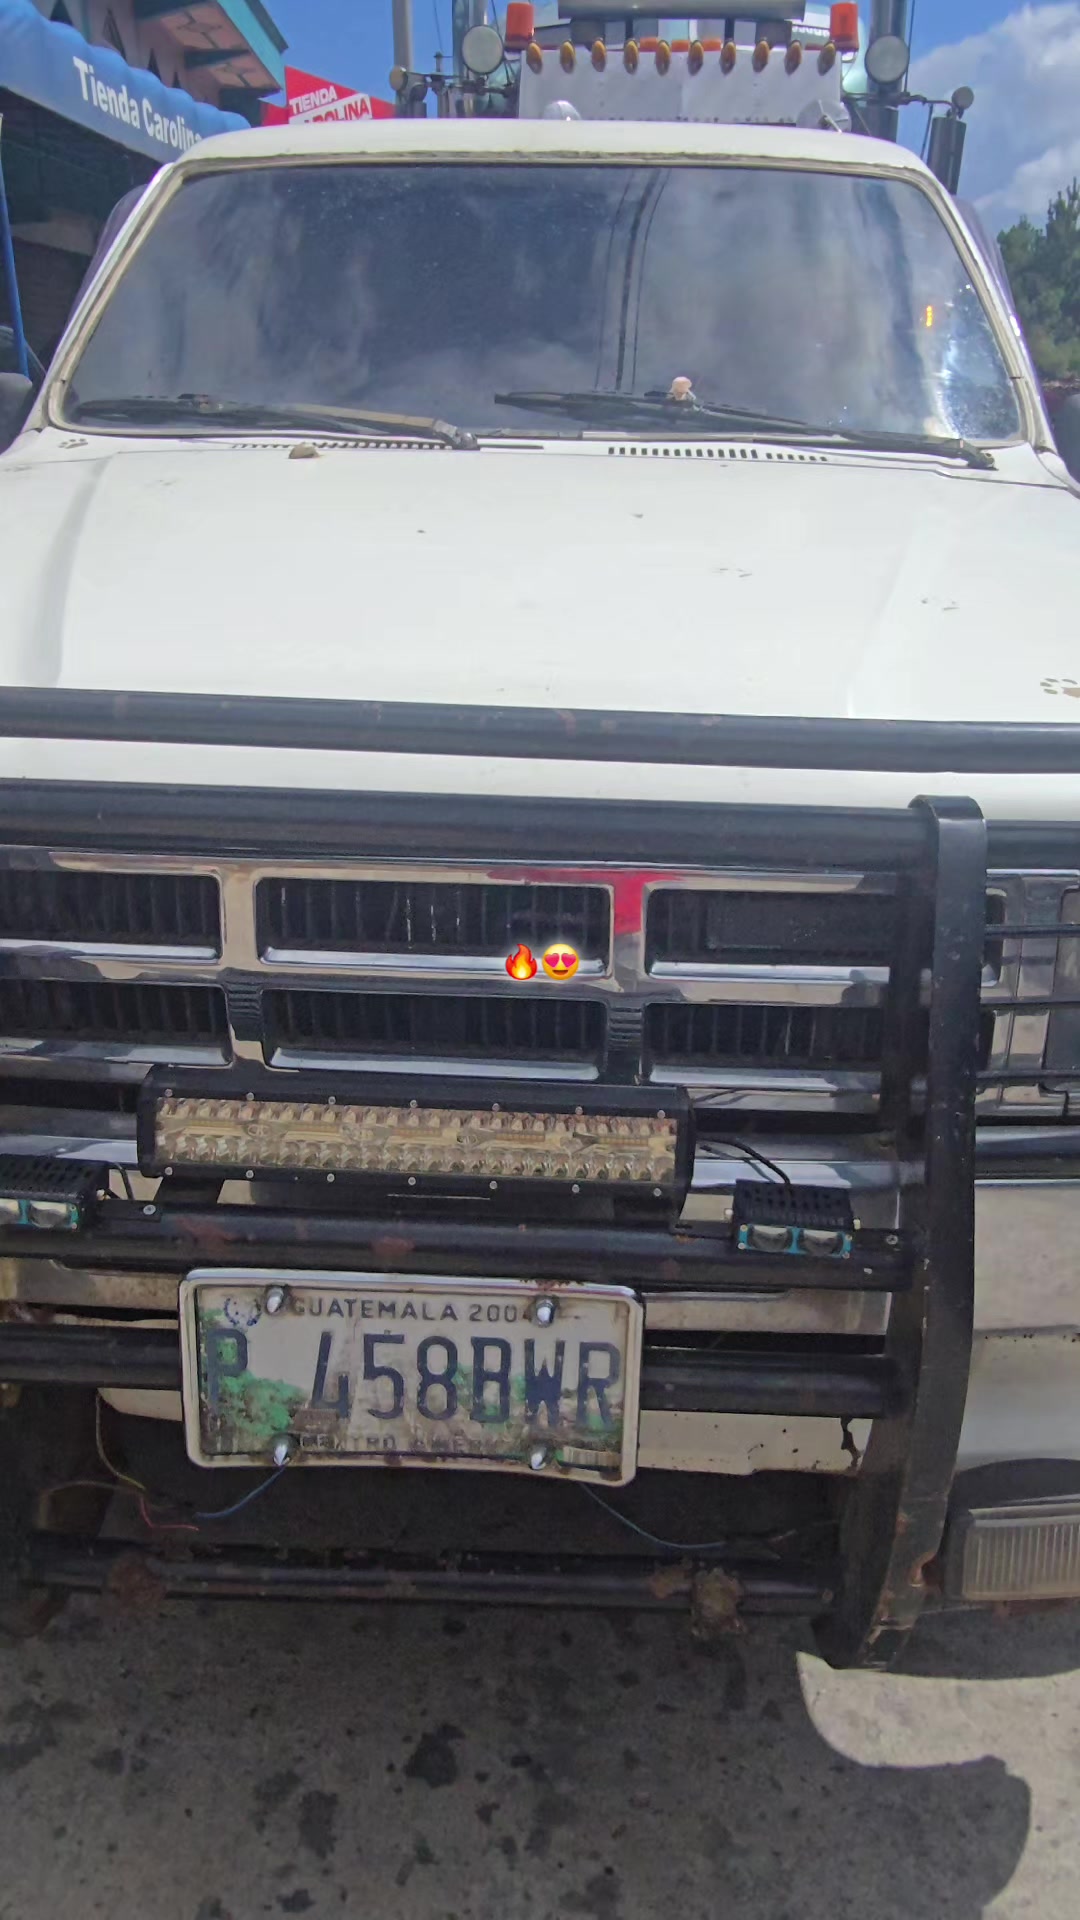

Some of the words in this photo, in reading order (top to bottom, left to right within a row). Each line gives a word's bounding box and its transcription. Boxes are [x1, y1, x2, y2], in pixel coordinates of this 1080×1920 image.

[72, 56, 140, 129] Tienda
[288, 85, 338, 115] TIENDA
[292, 1298, 458, 1323] GUATEMALA
[468, 1303, 532, 1324] 200
[205, 1328, 248, 1418] P
[309, 1330, 621, 1432] 458BWR
